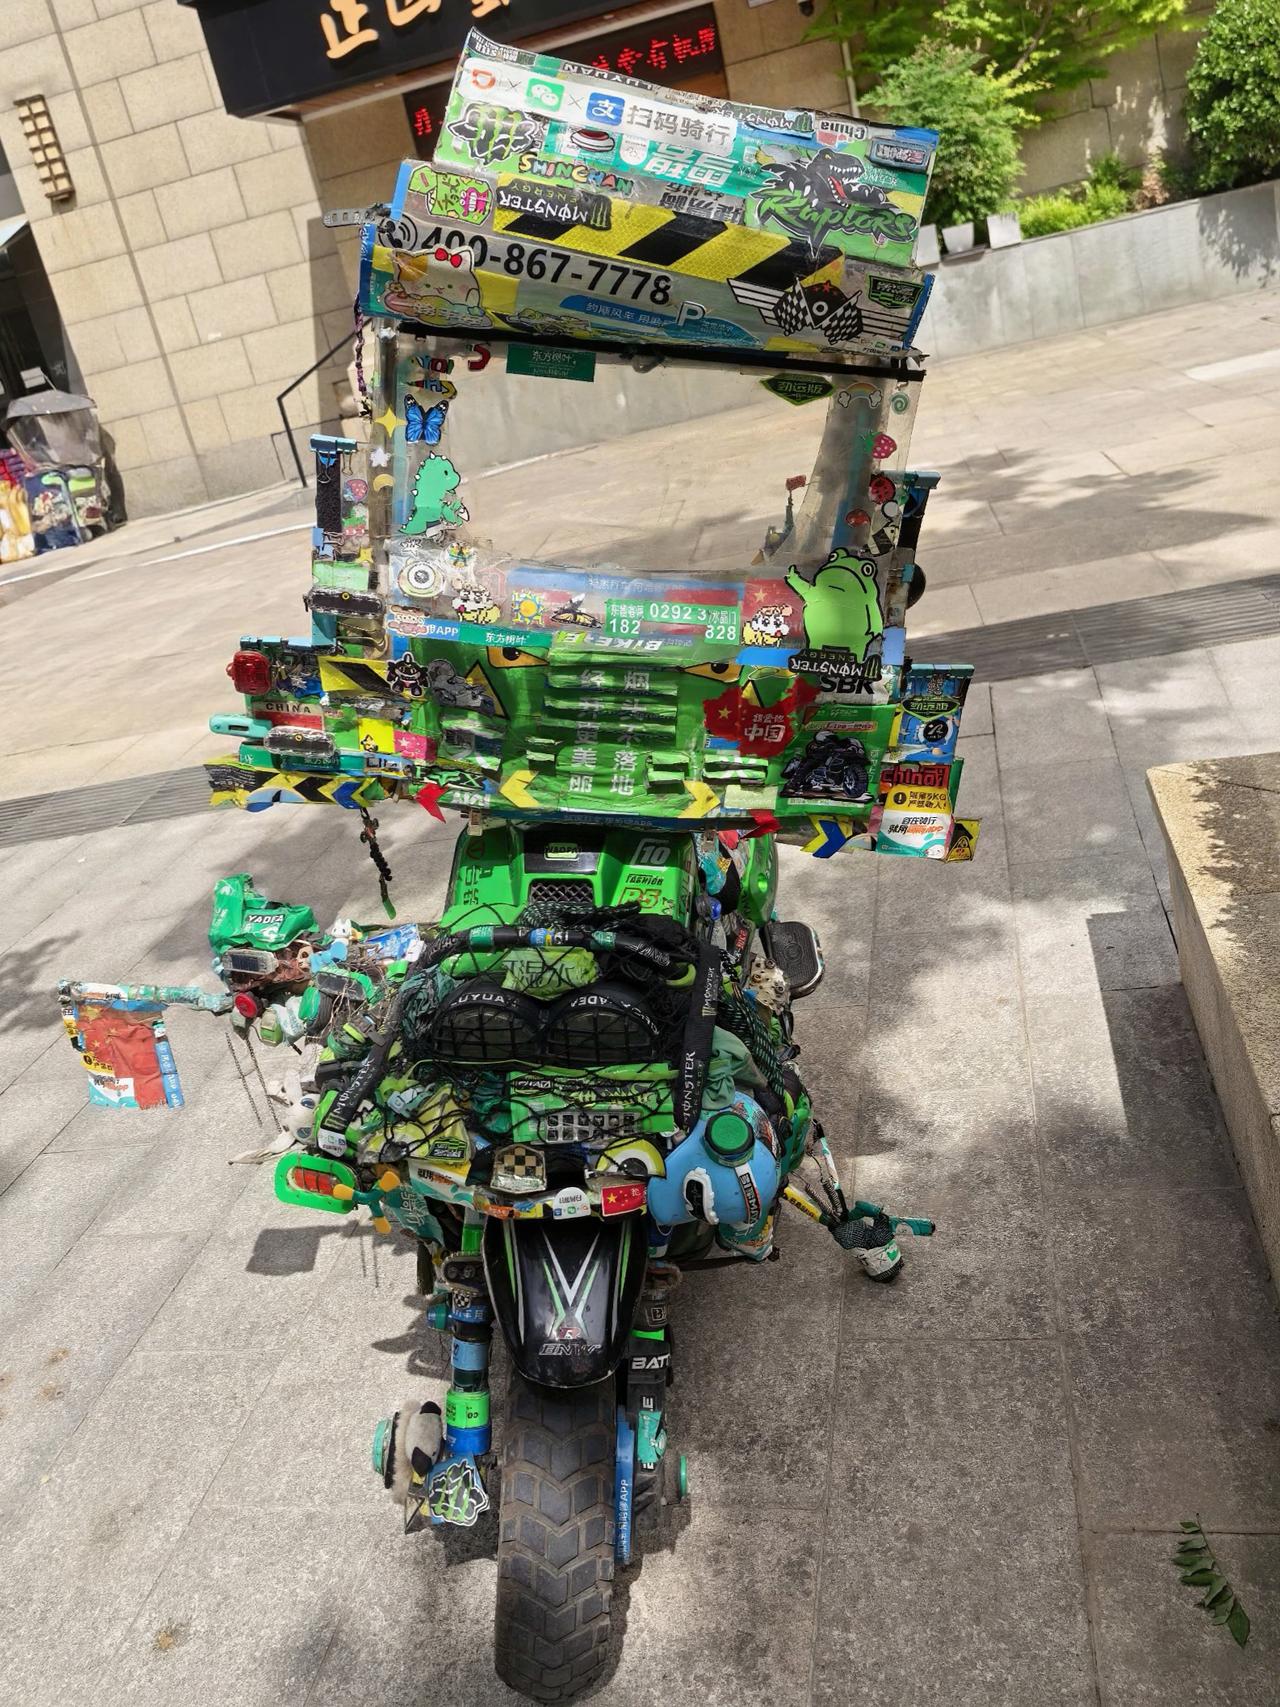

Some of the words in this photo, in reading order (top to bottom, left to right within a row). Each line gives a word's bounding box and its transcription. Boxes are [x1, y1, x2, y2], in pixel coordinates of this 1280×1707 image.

[563, 62, 653, 91] LUYUAN
[627, 103, 731, 146] 扫码骑行
[518, 151, 635, 197] SHINCHAN
[511, 182, 579, 204] ENERGY
[498, 190, 589, 222] MONSTER
[649, 602, 693, 621] 0292
[609, 618, 641, 635] 182
[484, 632, 529, 645] 东方树叶
[791, 657, 864, 678] MONSTER
[265, 703, 312, 714] CHINA
[743, 723, 786, 743] 中国
[642, 846, 672, 866] 10
